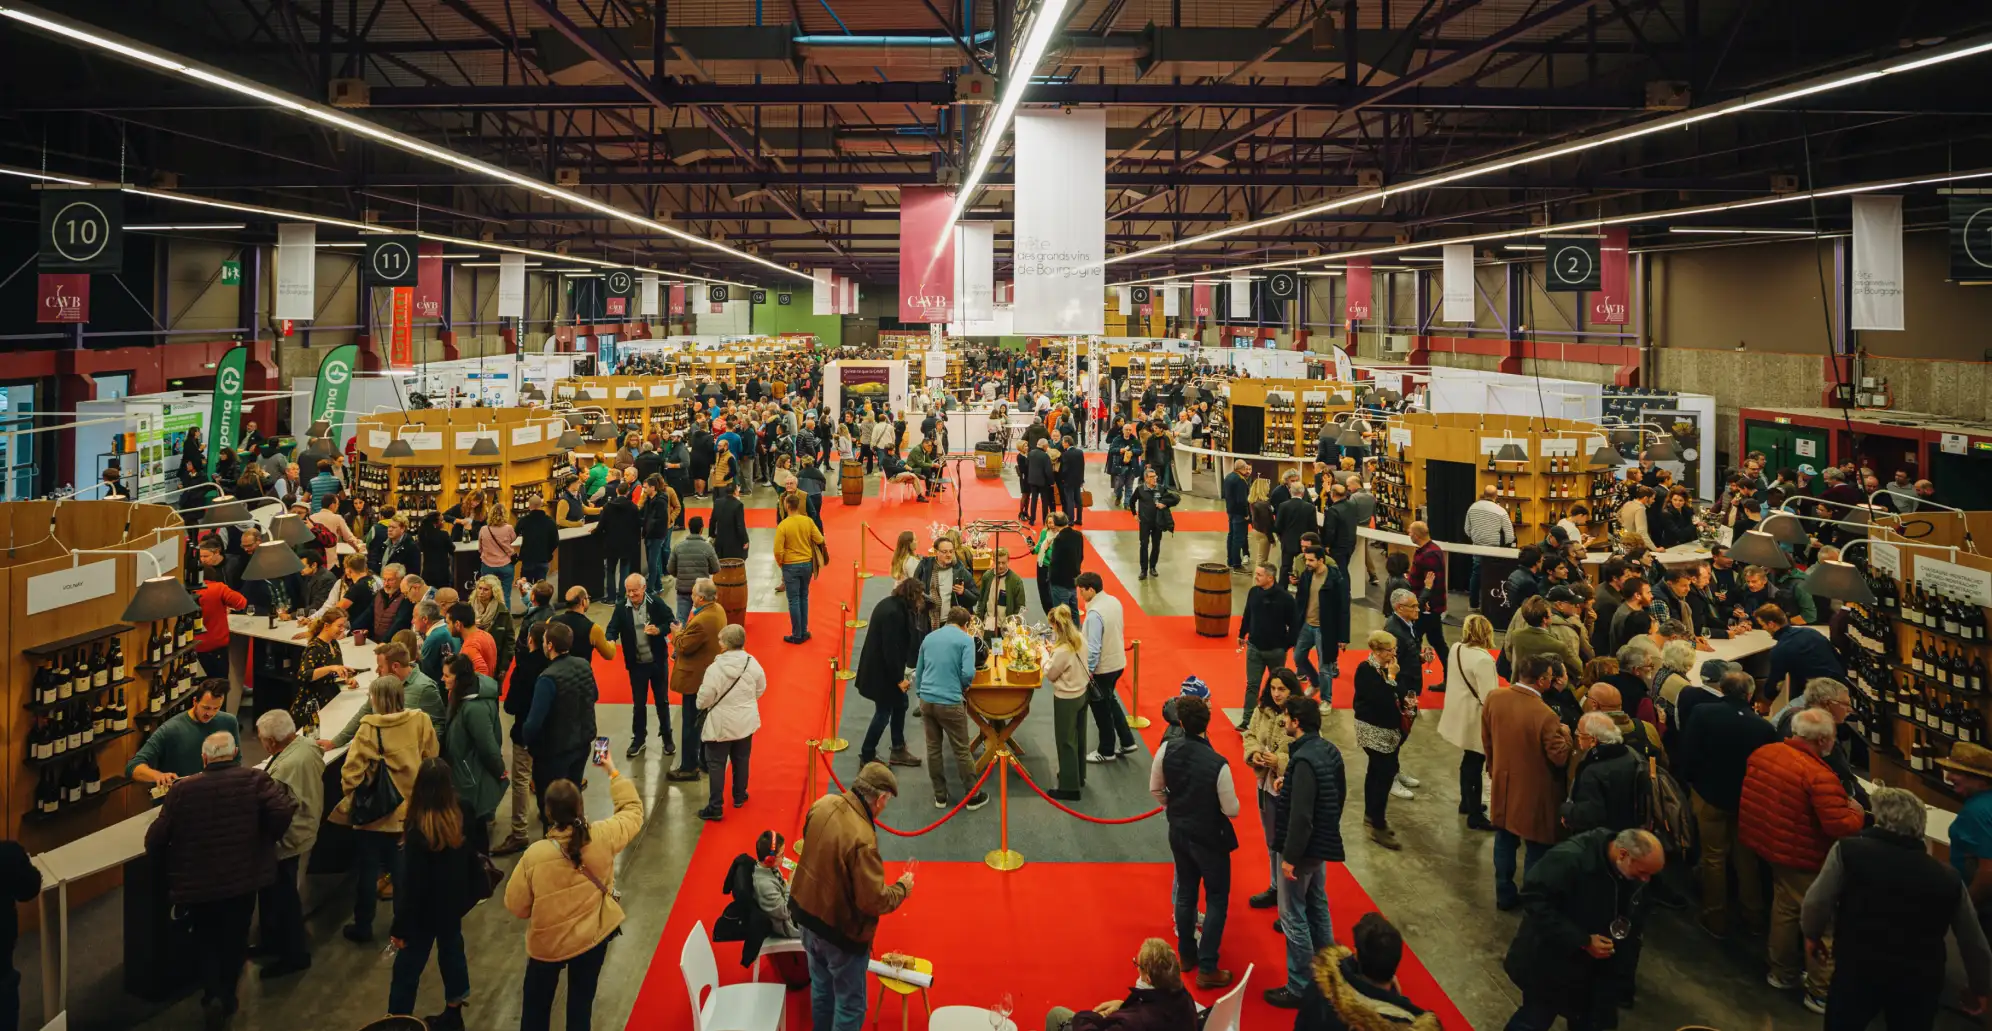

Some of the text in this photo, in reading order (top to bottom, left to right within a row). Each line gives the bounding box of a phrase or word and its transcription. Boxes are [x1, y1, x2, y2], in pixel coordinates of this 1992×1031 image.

[66, 219, 97, 244] 10
[382, 253, 400, 269] 11
[1037, 250, 1069, 262] grands
[1071, 250, 1090, 261] vins
[1017, 264, 1101, 278] de Bourgogne
[1567, 257, 1578, 273] 2
[614, 277, 626, 287] 12
[1279, 280, 1285, 290] 3
[716, 289, 723, 298] 13
[45, 296, 81, 308] CAVB
[416, 301, 438, 310] CAVB
[907, 295, 946, 308] CAVB
[1596, 304, 1625, 314] CAVB
[62, 581, 84, 590] VOLNAY
